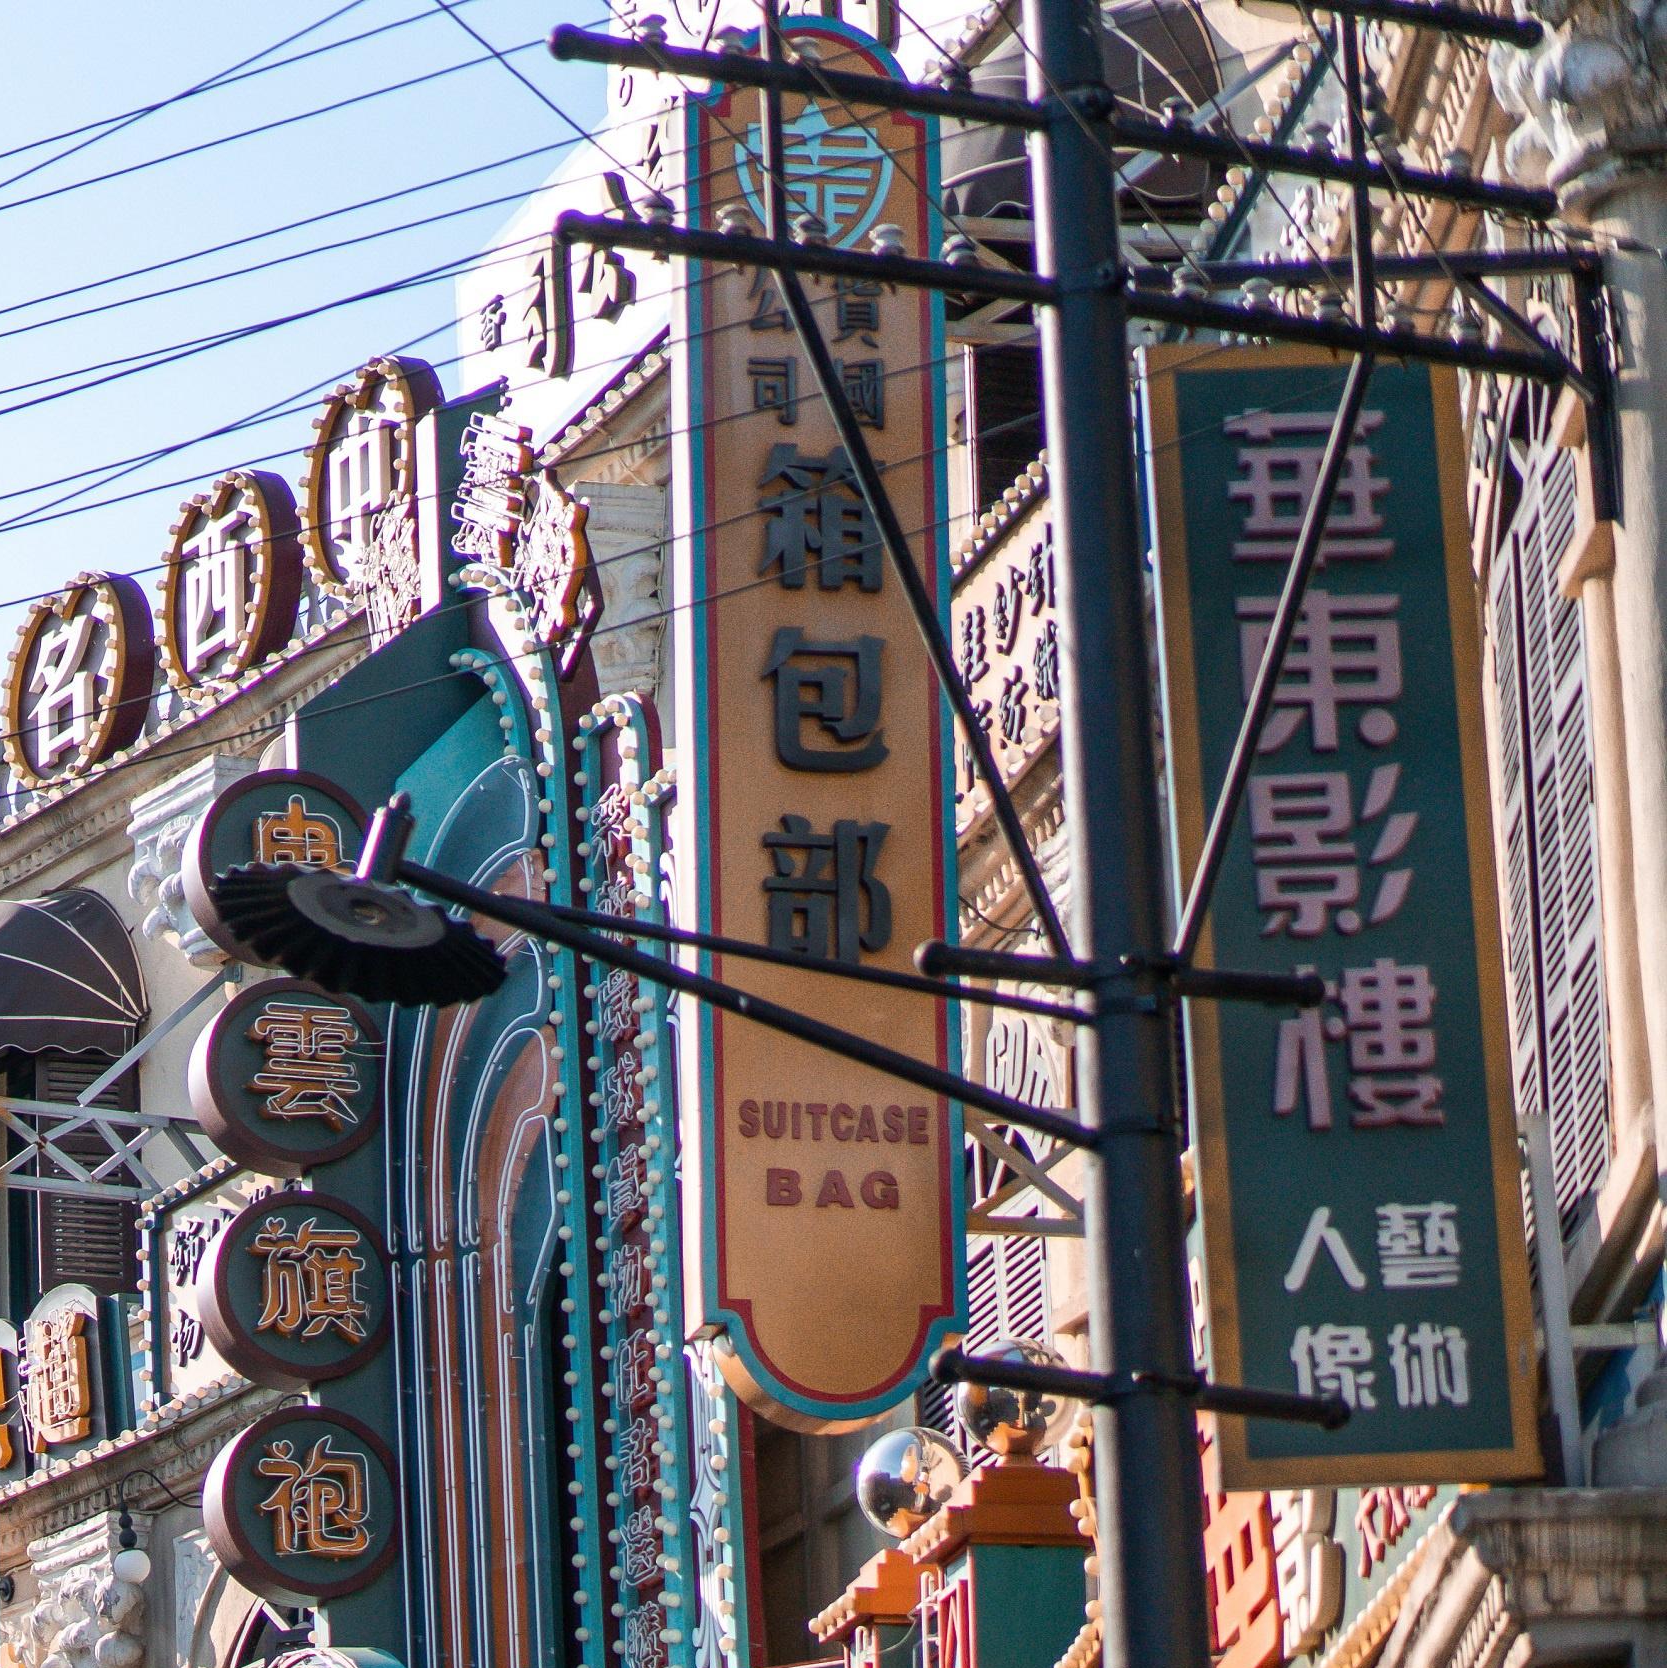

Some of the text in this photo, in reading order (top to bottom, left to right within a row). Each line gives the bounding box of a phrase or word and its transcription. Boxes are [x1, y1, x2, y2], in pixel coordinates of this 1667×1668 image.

[759, 439, 892, 967] 箱包部
[739, 1099, 930, 1147] SUITCASE
[765, 1170, 900, 1211] BAG
